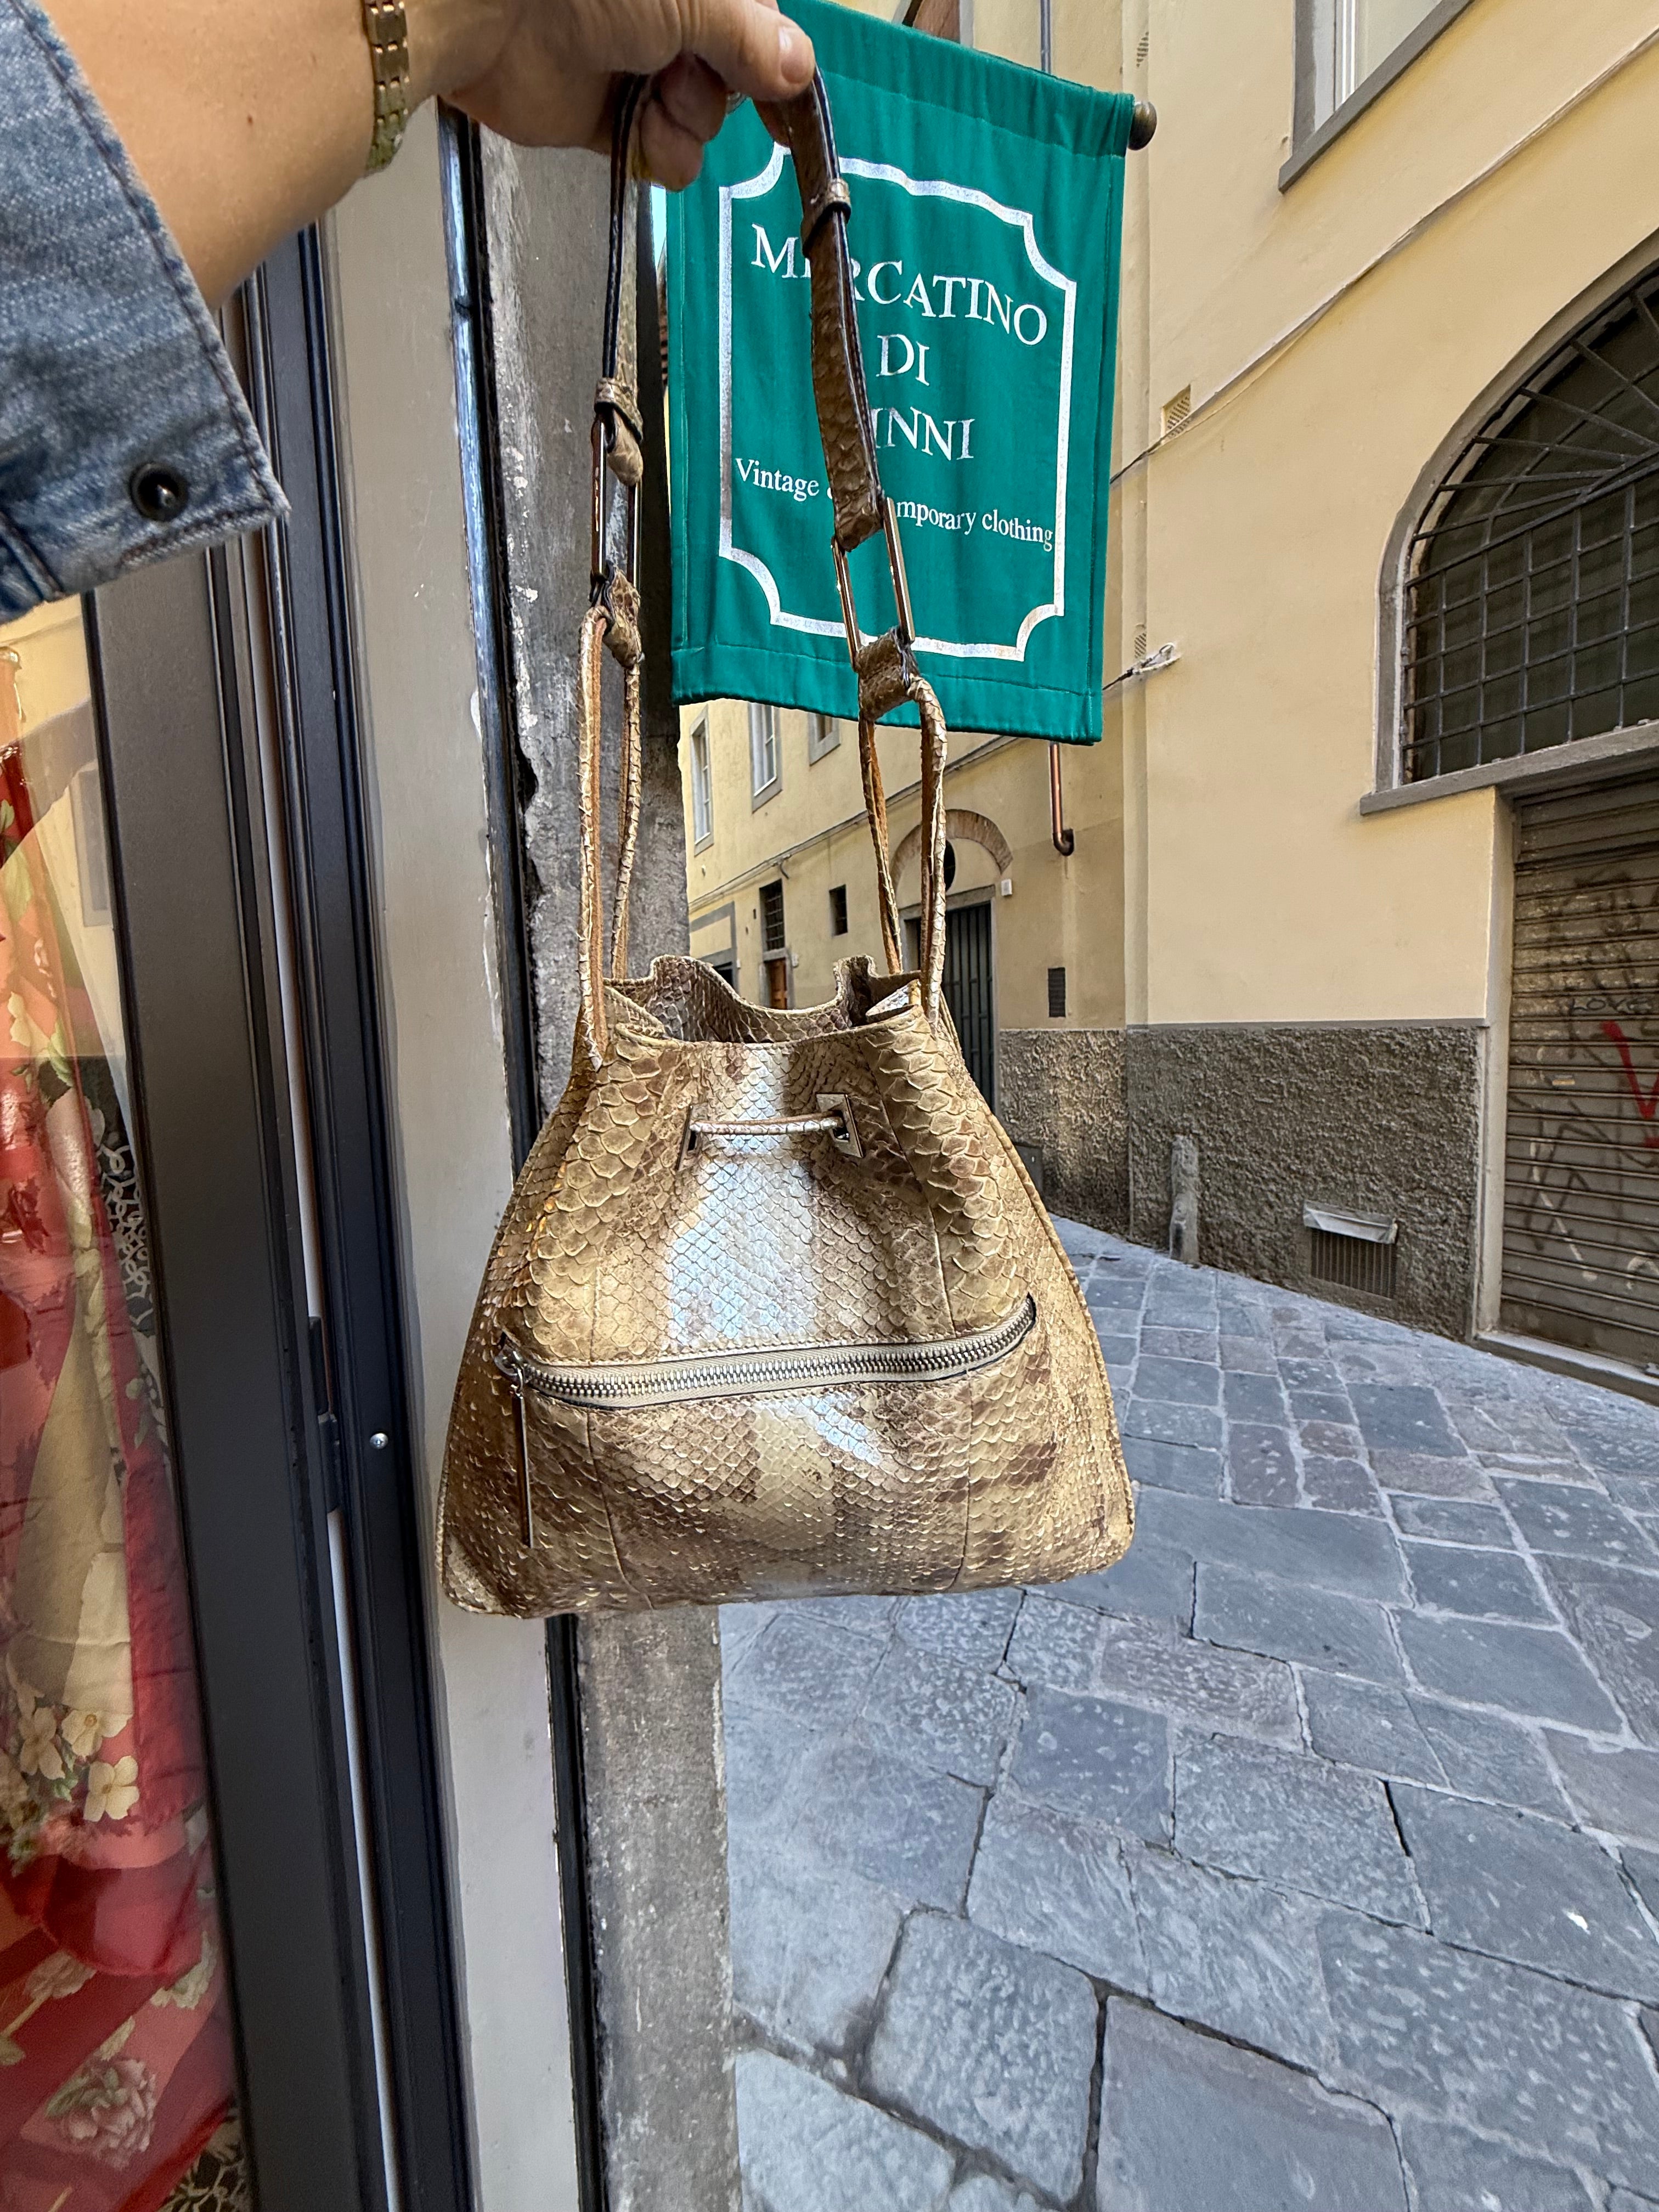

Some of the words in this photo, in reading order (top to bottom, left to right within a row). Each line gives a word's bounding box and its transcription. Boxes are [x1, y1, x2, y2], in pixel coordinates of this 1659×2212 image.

[751, 223, 1047, 346] MCATINO
[877, 334, 930, 386] DI
[870, 406, 975, 461] INNI
[735, 458, 820, 502] Vintage
[981, 509, 1053, 552] clothing
